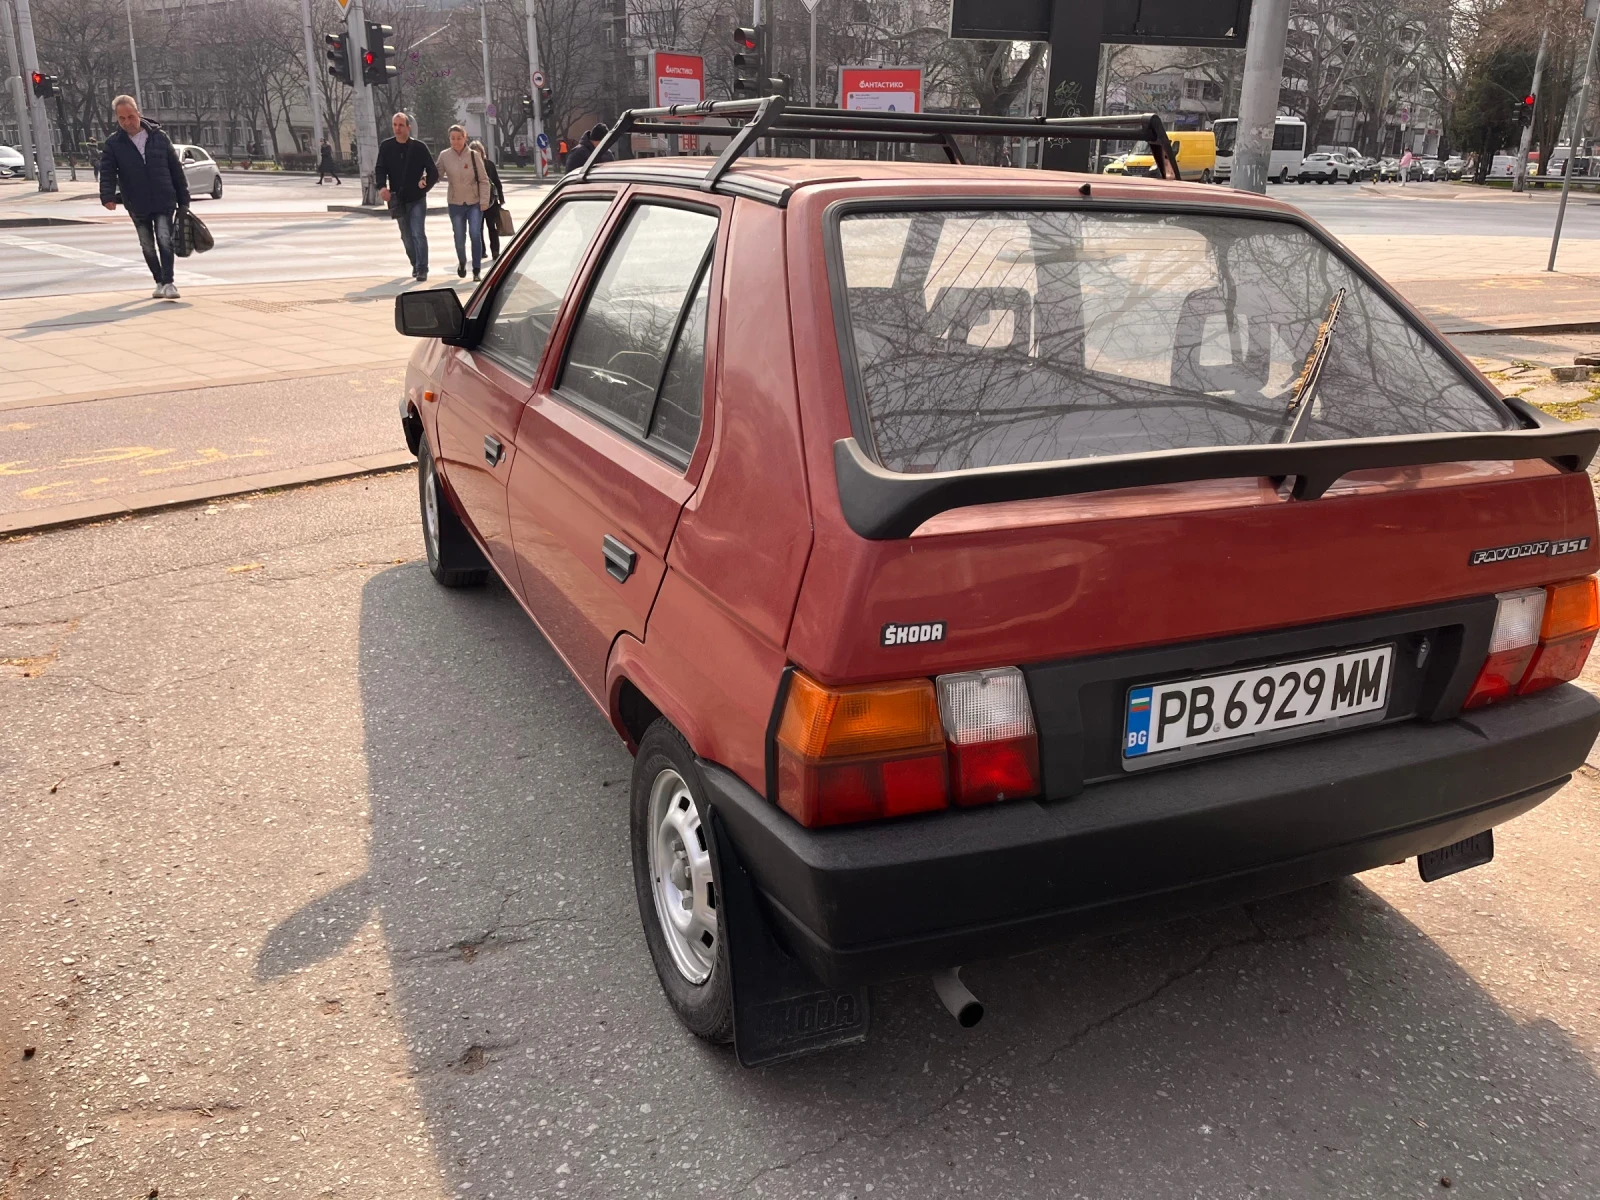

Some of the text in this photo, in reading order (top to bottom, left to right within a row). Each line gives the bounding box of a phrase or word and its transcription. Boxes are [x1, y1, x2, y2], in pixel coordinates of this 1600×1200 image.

[859, 80, 904, 88] ФАНТАСТИКО
[1473, 539, 1588, 565] FAVORIT 135L
[884, 623, 943, 645] ŠKODA
[1157, 655, 1386, 744] PB 6929 MM
[1128, 731, 1147, 748] BG
